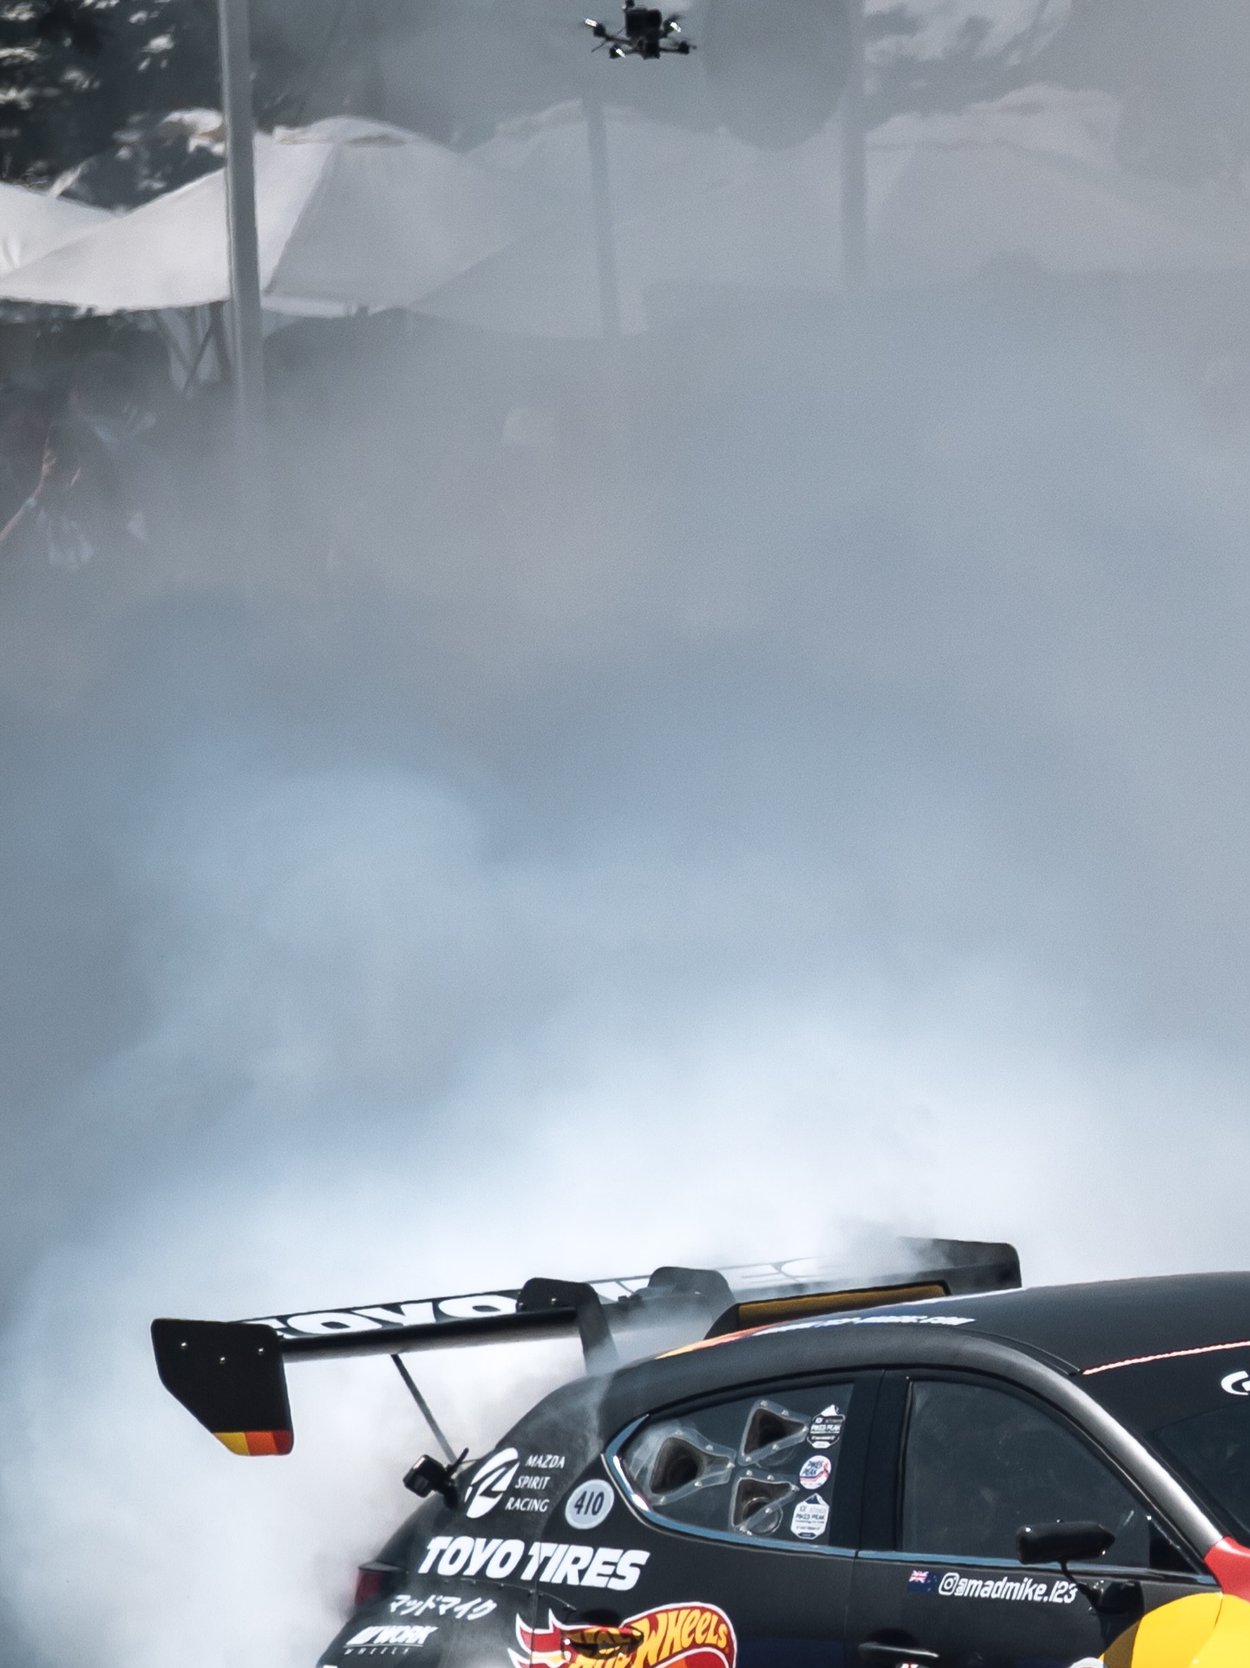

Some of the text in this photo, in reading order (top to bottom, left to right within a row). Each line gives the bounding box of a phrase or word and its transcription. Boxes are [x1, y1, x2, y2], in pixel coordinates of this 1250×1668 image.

[525, 1454, 566, 1469] MAZDA
[514, 1475, 550, 1490] SPIRIT
[505, 1497, 550, 1512] RACING
[574, 1490, 605, 1516] 410
[417, 1535, 651, 1592] TOYO TIRES
[954, 1576, 1078, 1604] @madmike.123
[390, 1594, 497, 1621] マッドマイク
